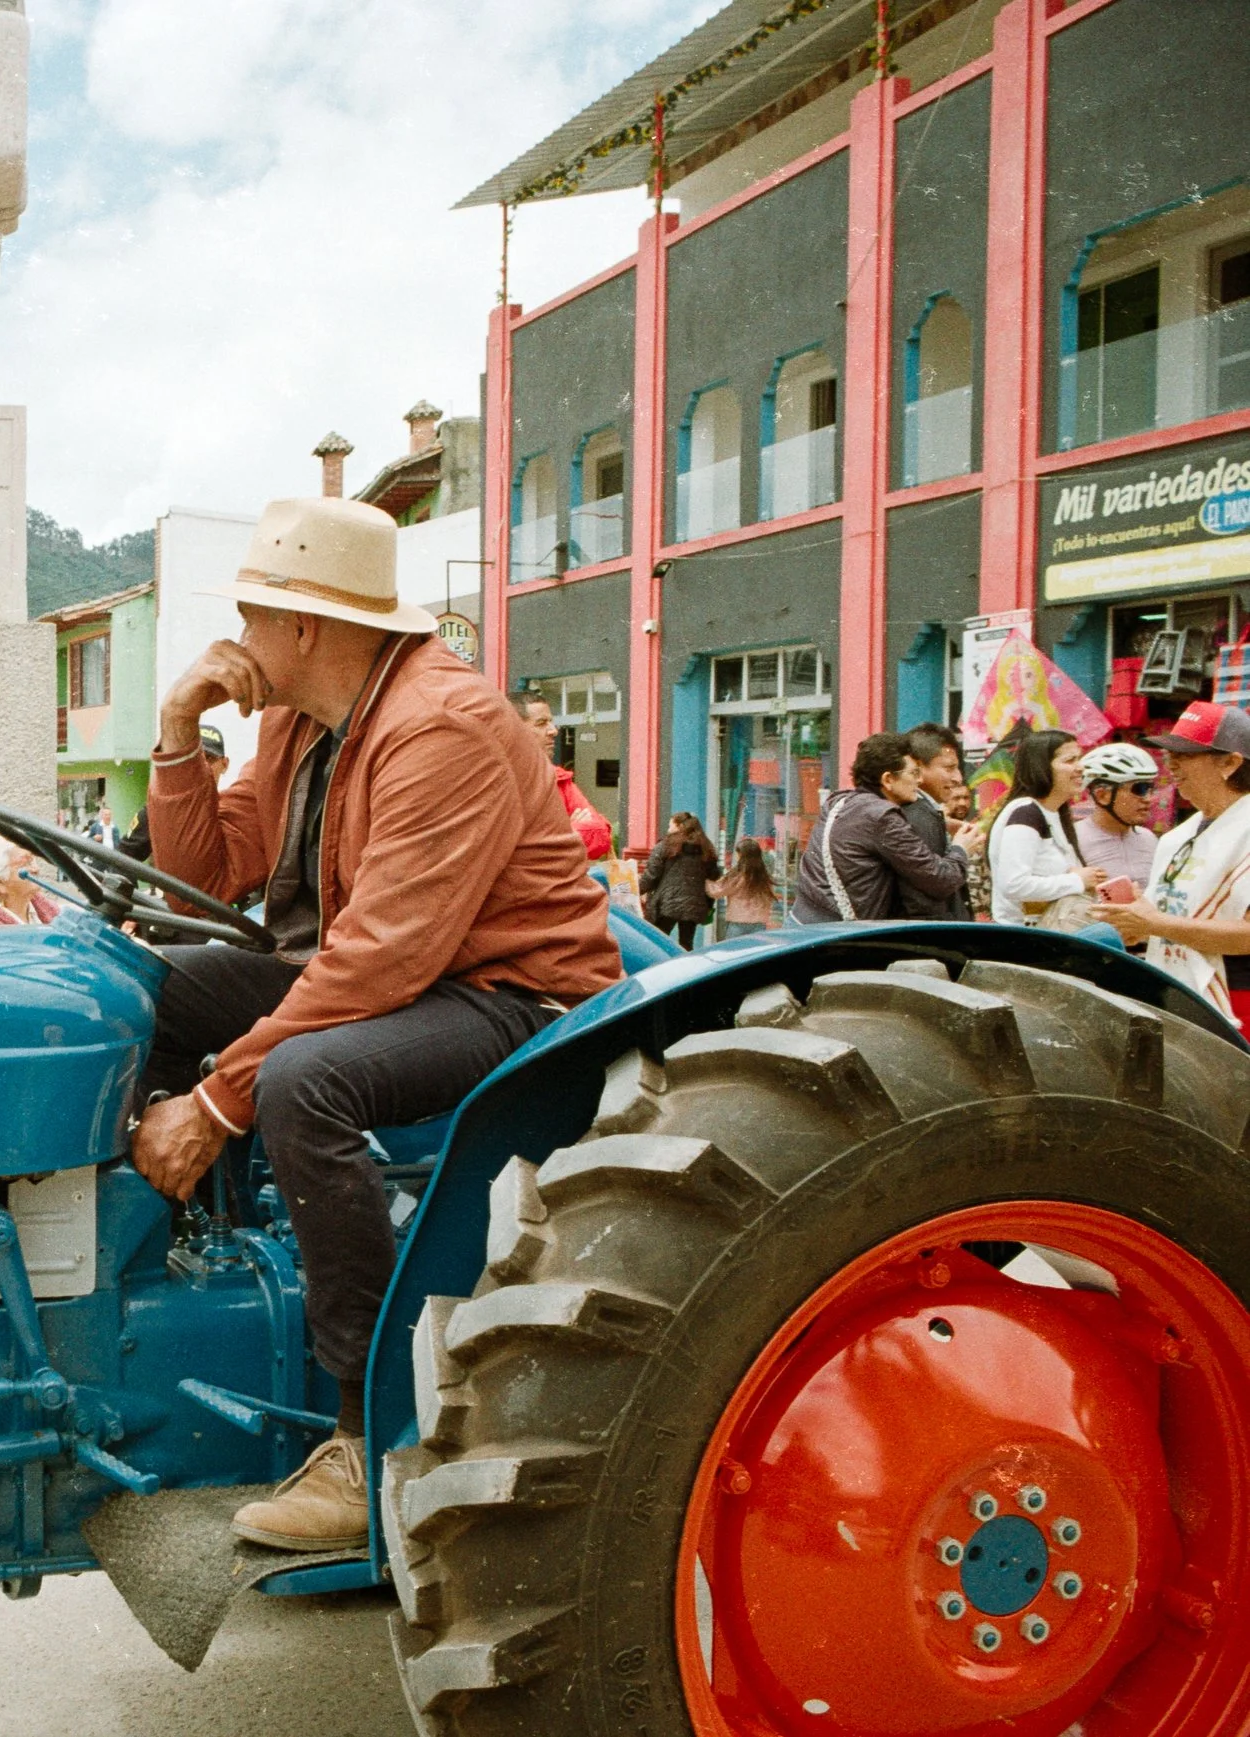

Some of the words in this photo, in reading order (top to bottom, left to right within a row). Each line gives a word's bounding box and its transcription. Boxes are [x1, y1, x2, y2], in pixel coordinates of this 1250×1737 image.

[1053, 483, 1098, 526] Mil
[1102, 456, 1250, 518] variedades
[1208, 503, 1221, 527] EL
[436, 621, 470, 638] OTEL
